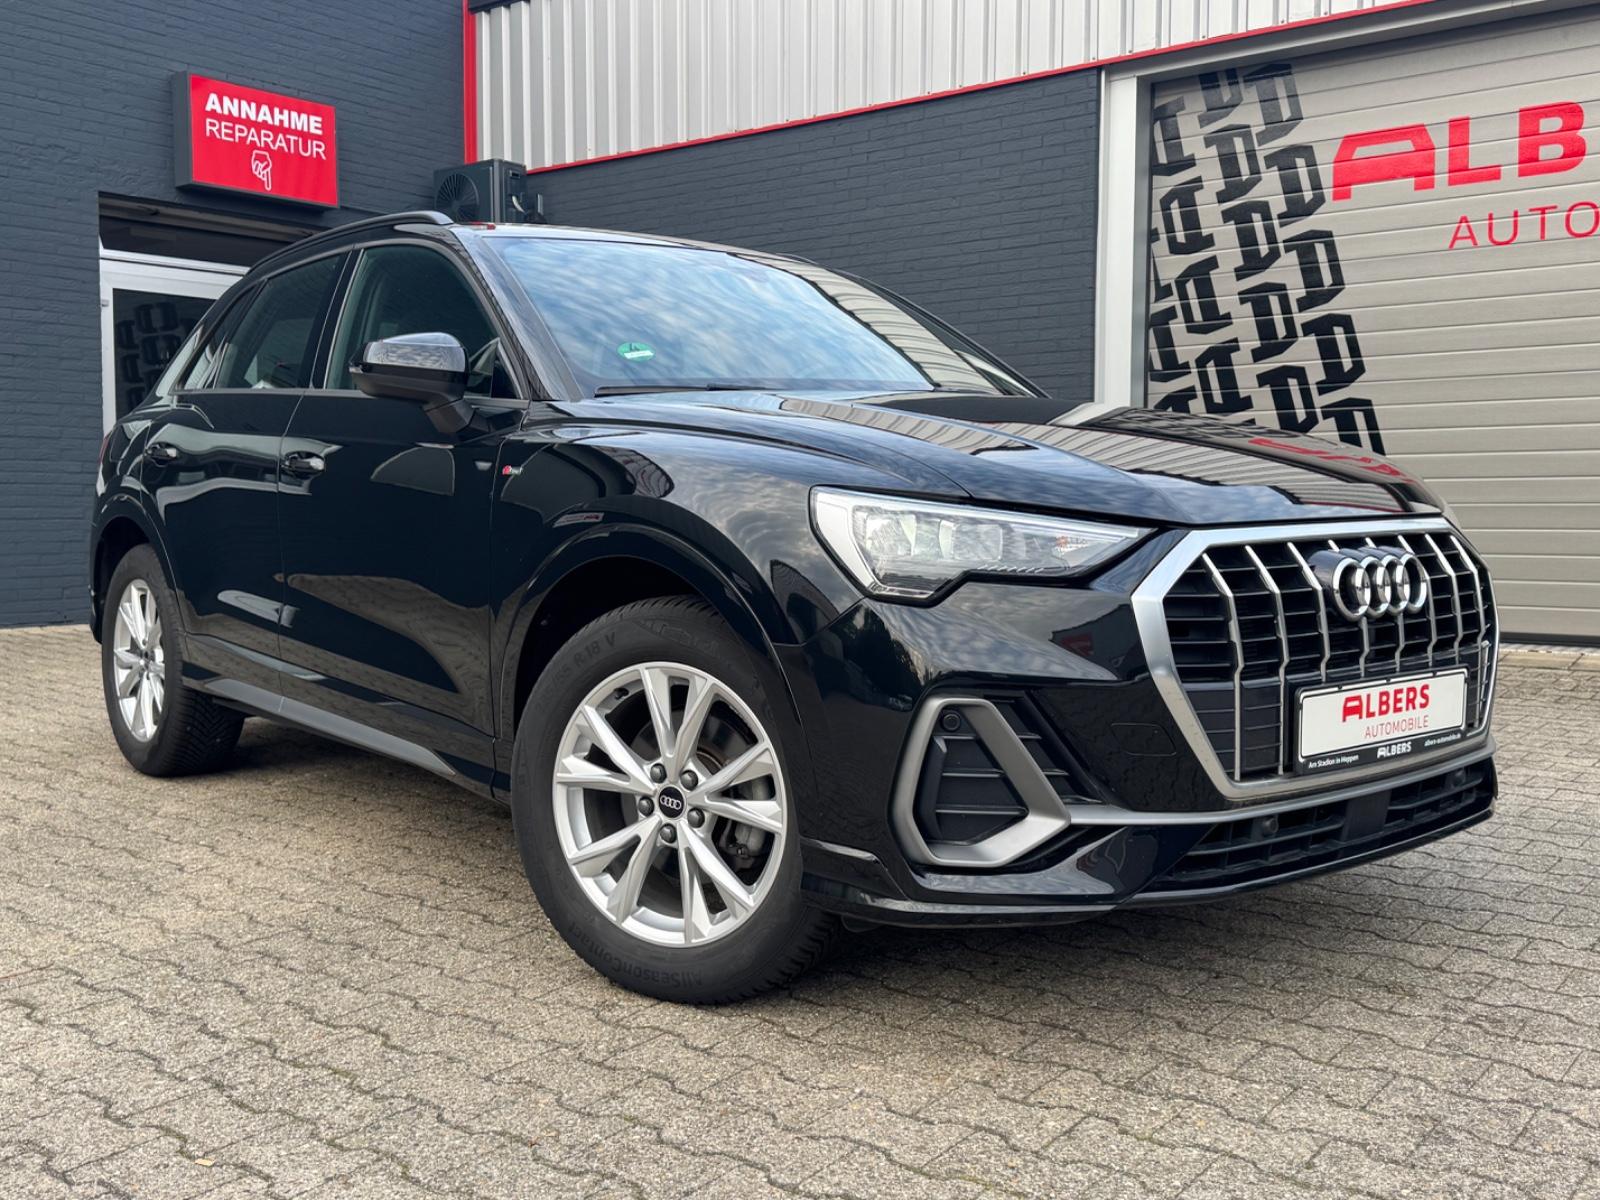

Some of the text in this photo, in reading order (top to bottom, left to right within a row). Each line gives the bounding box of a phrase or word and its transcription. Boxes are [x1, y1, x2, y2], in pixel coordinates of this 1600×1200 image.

[205, 93, 323, 135] ANNAHME
[205, 118, 327, 160] REPARATUR
[1449, 201, 1600, 249] AUTO
[1342, 684, 1430, 722] ALBERS
[1364, 715, 1429, 739] AUTOMOBILE
[1317, 758, 1335, 767] Stadion
[1377, 742, 1412, 758] ALBERS
